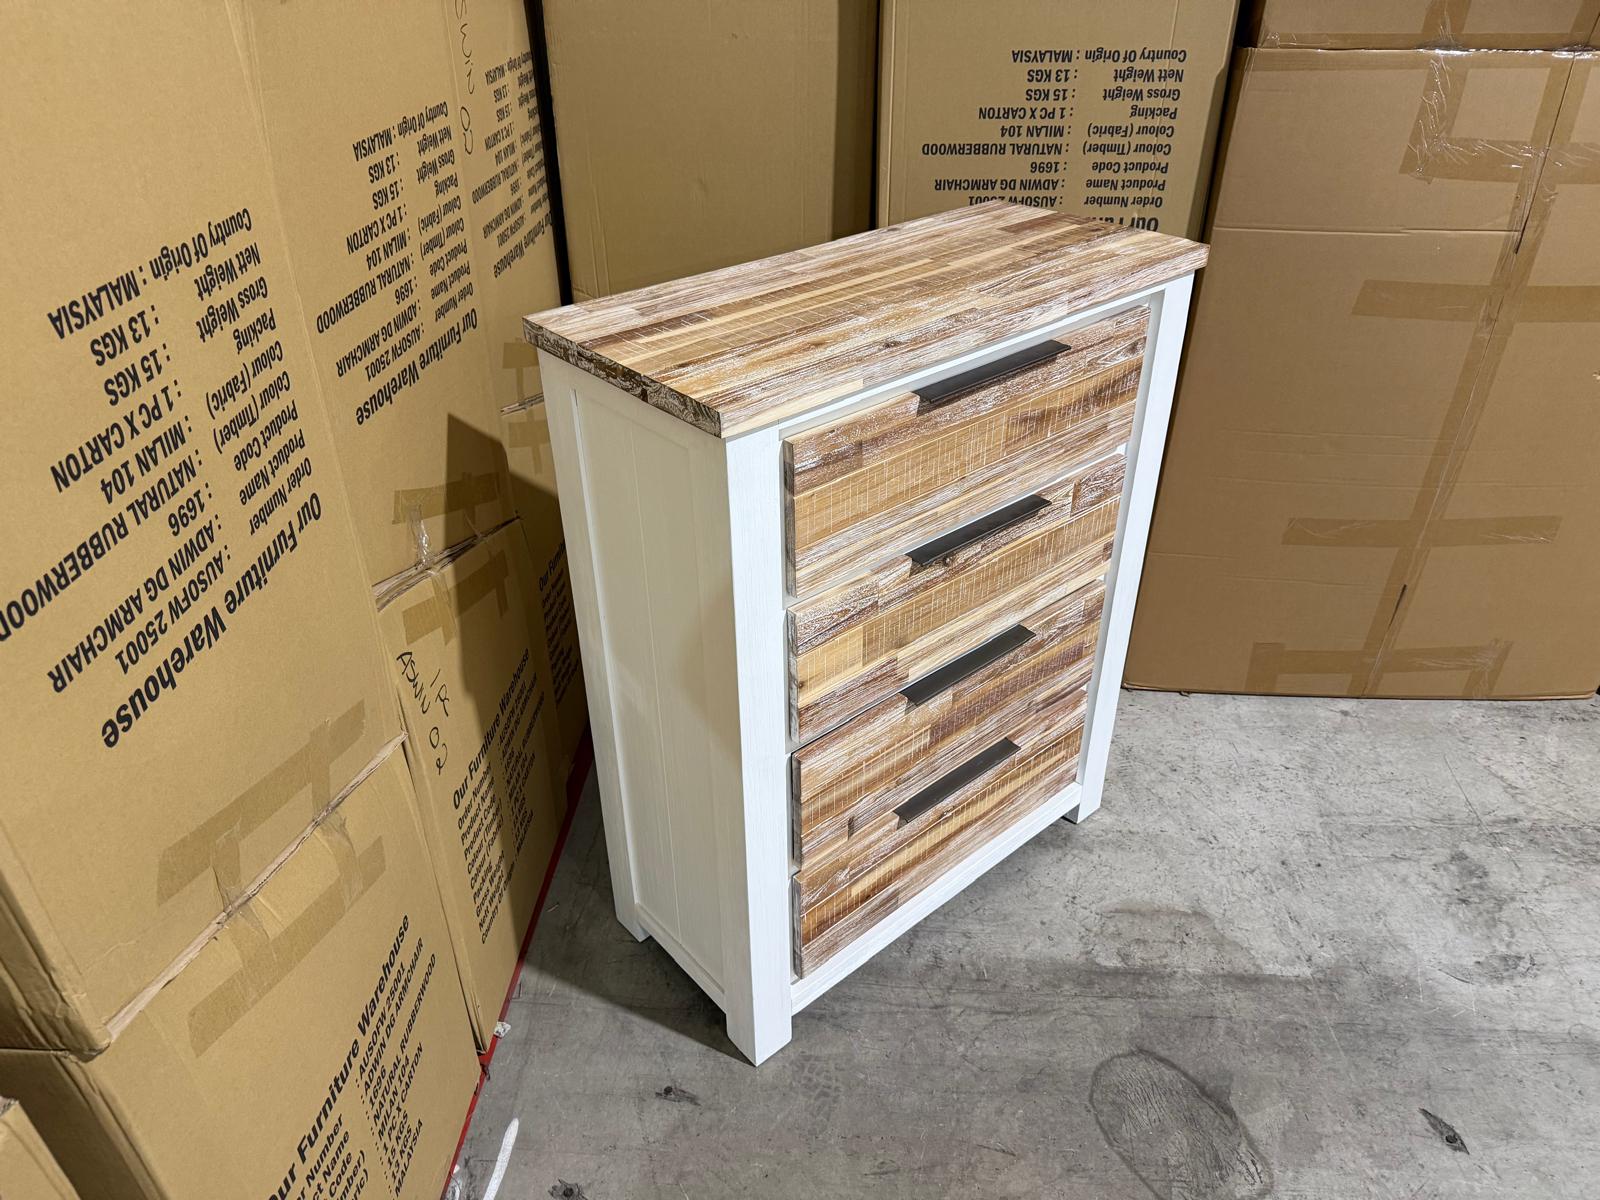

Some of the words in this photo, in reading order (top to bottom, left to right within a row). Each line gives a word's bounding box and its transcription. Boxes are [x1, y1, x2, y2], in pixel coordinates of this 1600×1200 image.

[1011, 49, 1072, 63] MALAYSIA
[1084, 46, 1120, 62] Origin
[1121, 49, 1136, 63] Of
[1138, 46, 1186, 62] Country
[1026, 68, 1051, 82] KGS
[1054, 68, 1070, 82] 13
[1112, 65, 1154, 82] Weight
[1157, 68, 1183, 82] Nett
[1025, 88, 1049, 101] KGS
[1052, 88, 1068, 101] 15
[1102, 85, 1143, 101] Weight
[1146, 88, 1180, 101] Gross
[416, 112, 425, 131] Of
[424, 100, 448, 122] Country
[978, 106, 1026, 119] CARTON
[1028, 106, 1037, 119] X
[1039, 106, 1055, 119] PC
[1059, 106, 1065, 119] 1
[1128, 104, 1177, 119] Packing
[396, 116, 417, 138] Origin
[437, 124, 452, 145] Nett
[1000, 124, 1022, 137] 104
[1025, 124, 1064, 137] MILAN
[1086, 122, 1133, 137] (Fabric)
[1135, 124, 1174, 137] Colour
[352, 126, 392, 160] MALAYSIA
[416, 131, 439, 157] Weight
[921, 142, 1006, 155] RUBBERWOOD
[1008, 142, 1062, 155] NATURAL
[1082, 140, 1131, 155] (Timber)
[1132, 143, 1171, 155] Colour
[367, 159, 385, 184] KGS
[384, 154, 395, 175] 13
[415, 158, 438, 184] Weight
[437, 148, 454, 168] Gross
[1029, 161, 1060, 173] 1696
[1091, 161, 1120, 173] Code
[1122, 161, 1168, 173] Product
[371, 185, 388, 209] KGS
[388, 180, 399, 200] 15
[433, 171, 458, 198] Packing
[934, 178, 997, 190] ARMCHAIR
[999, 178, 1016, 190] DG
[1019, 178, 1059, 190] ADWIN
[1085, 178, 1118, 190] Name
[1120, 178, 1165, 191] Product
[396, 205, 402, 223] 1
[442, 194, 461, 216] Colour
[1083, 195, 1128, 207] Number
[1130, 195, 1162, 208] Order
[207, 208, 252, 245] Country
[378, 214, 386, 233] X
[385, 208, 397, 230] PC
[417, 203, 442, 236] (Fabric)
[445, 216, 464, 239] Colour
[1130, 217, 1159, 232] Our
[191, 232, 208, 262] Of
[345, 219, 379, 255] CARTON
[382, 229, 406, 260] MILAN
[419, 226, 445, 261] (Timber)
[148, 242, 192, 280] Origin
[234, 242, 261, 276] Nett
[365, 245, 381, 271] 104
[428, 255, 445, 277] Code
[444, 238, 467, 267] Product
[193, 258, 238, 302] Weight
[375, 253, 410, 291] NATURAL
[447, 259, 470, 289] Product
[236, 276, 268, 308] Gross
[394, 277, 413, 305] 1696
[430, 276, 448, 300] Name
[457, 280, 473, 303] Order
[46, 270, 140, 338] MALAYSIA
[316, 276, 376, 334] RUBBERWOOD
[392, 299, 416, 334] ADWIN
[434, 293, 457, 323] Number
[127, 309, 150, 344] 13
[195, 298, 240, 341] Weight
[232, 309, 276, 354] Packing
[380, 319, 393, 343] DG
[461, 306, 477, 335] Our
[89, 323, 128, 367] KGS
[335, 328, 379, 379] ARMCHAIR
[391, 322, 420, 363] AUSOFW
[418, 318, 461, 372] Furniture
[139, 348, 162, 382] 15
[250, 340, 283, 376] Colour
[364, 347, 390, 383] 25001
[103, 362, 141, 405] KGS
[160, 385, 173, 411] 1
[204, 363, 251, 418] (Fabric)
[258, 370, 290, 408] Colour
[355, 357, 419, 426] Warehouse
[122, 409, 140, 438] X
[137, 394, 162, 428] PC
[211, 396, 259, 453] (Timber)
[258, 400, 298, 447] Product
[49, 422, 124, 492] CARTON
[134, 420, 185, 476] MILAN
[232, 437, 261, 470] Code
[267, 429, 305, 477] Product
[99, 459, 134, 503] 104
[125, 454, 196, 525] NATURAL
[238, 466, 270, 504] Name
[286, 458, 311, 492] Order
[167, 489, 204, 536] 1696
[248, 485, 287, 535] Number
[296, 492, 321, 533] Our
[167, 518, 214, 580] ADWIN
[223, 519, 297, 614] Furniture
[142, 565, 168, 601] DG
[167, 549, 223, 624] AUSOFW
[46, 586, 143, 694] ARMCHAIR
[114, 609, 167, 674] 25001
[100, 605, 226, 747] Warehouse
[297, 1038, 360, 1165] Furniture
[357, 914, 409, 1037] Warehouse
[373, 1053, 401, 1127] NATURAL
[399, 953, 435, 1054] RUBBERWOOD
[306, 1113, 342, 1188] Number
[359, 1005, 386, 1082] AUSOFW
[385, 961, 405, 1011] 25001
[322, 1131, 349, 1184] Name
[364, 1035, 386, 1098] ADWIN
[385, 1012, 395, 1040] DG
[394, 937, 423, 1017] ARMCHAIR
[378, 1084, 398, 1141] MILAN
[397, 1053, 409, 1087] 104
[382, 1140, 388, 1155] 1
[387, 1115, 397, 1142] PC
[395, 1101, 402, 1118] X
[401, 1040, 422, 1103] CARTON
[329, 1152, 352, 1198] Code
[369, 1064, 386, 1110] 1696
[387, 1143, 396, 1170] 15
[394, 1109, 408, 1146] KGS
[391, 1158, 400, 1183] 13
[399, 1123, 411, 1160] KGS
[395, 1118, 422, 1198] MALAYSIA
